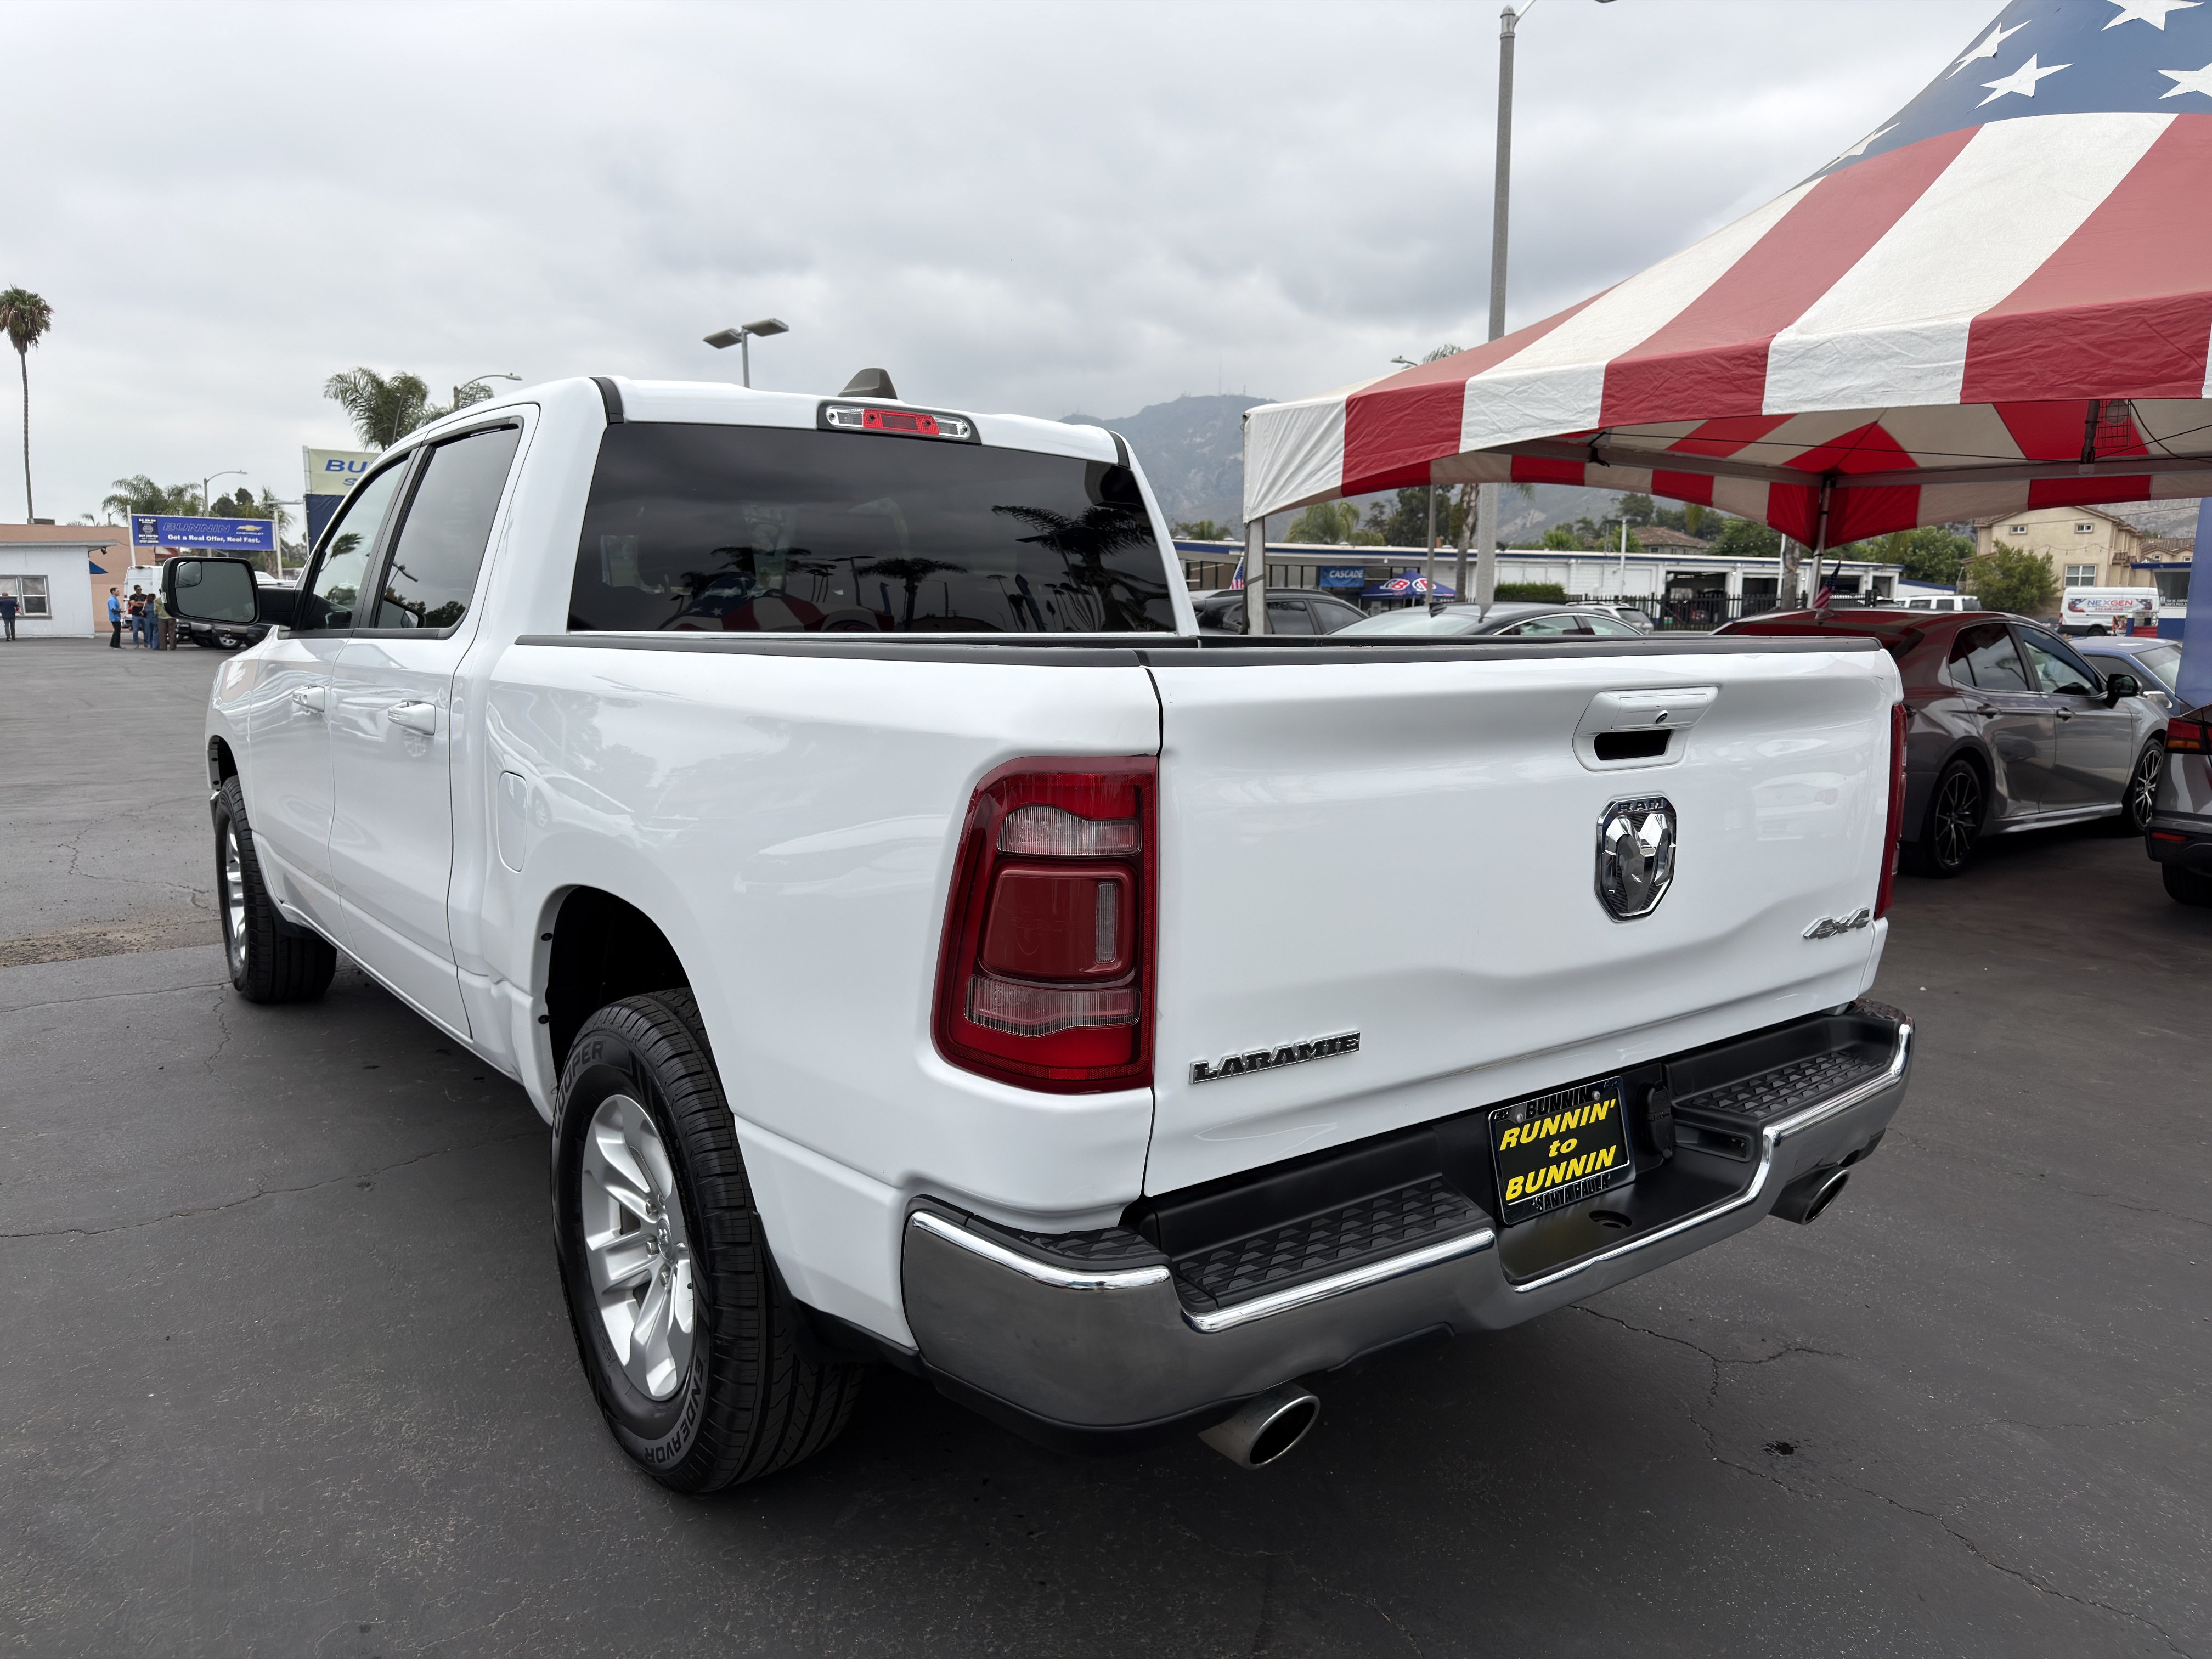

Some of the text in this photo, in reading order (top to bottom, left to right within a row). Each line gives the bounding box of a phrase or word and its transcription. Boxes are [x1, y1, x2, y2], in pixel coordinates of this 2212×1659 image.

[163, 522, 231, 533] BUNNIN
[1329, 569, 1364, 578] CASCADE
[1618, 799, 1664, 814] RAM
[1803, 907, 1871, 939] 4x4
[1189, 1031, 1361, 1085] LARAMIE
[554, 1040, 606, 1139] COOPER
[1525, 1085, 1590, 1120] BUNNIN
[1499, 1098, 1616, 1151] RUNNIN'
[1548, 1138, 1577, 1158] to
[1505, 1144, 1617, 1201] BUNNIN
[644, 1352, 704, 1464] ENDEAVOR
